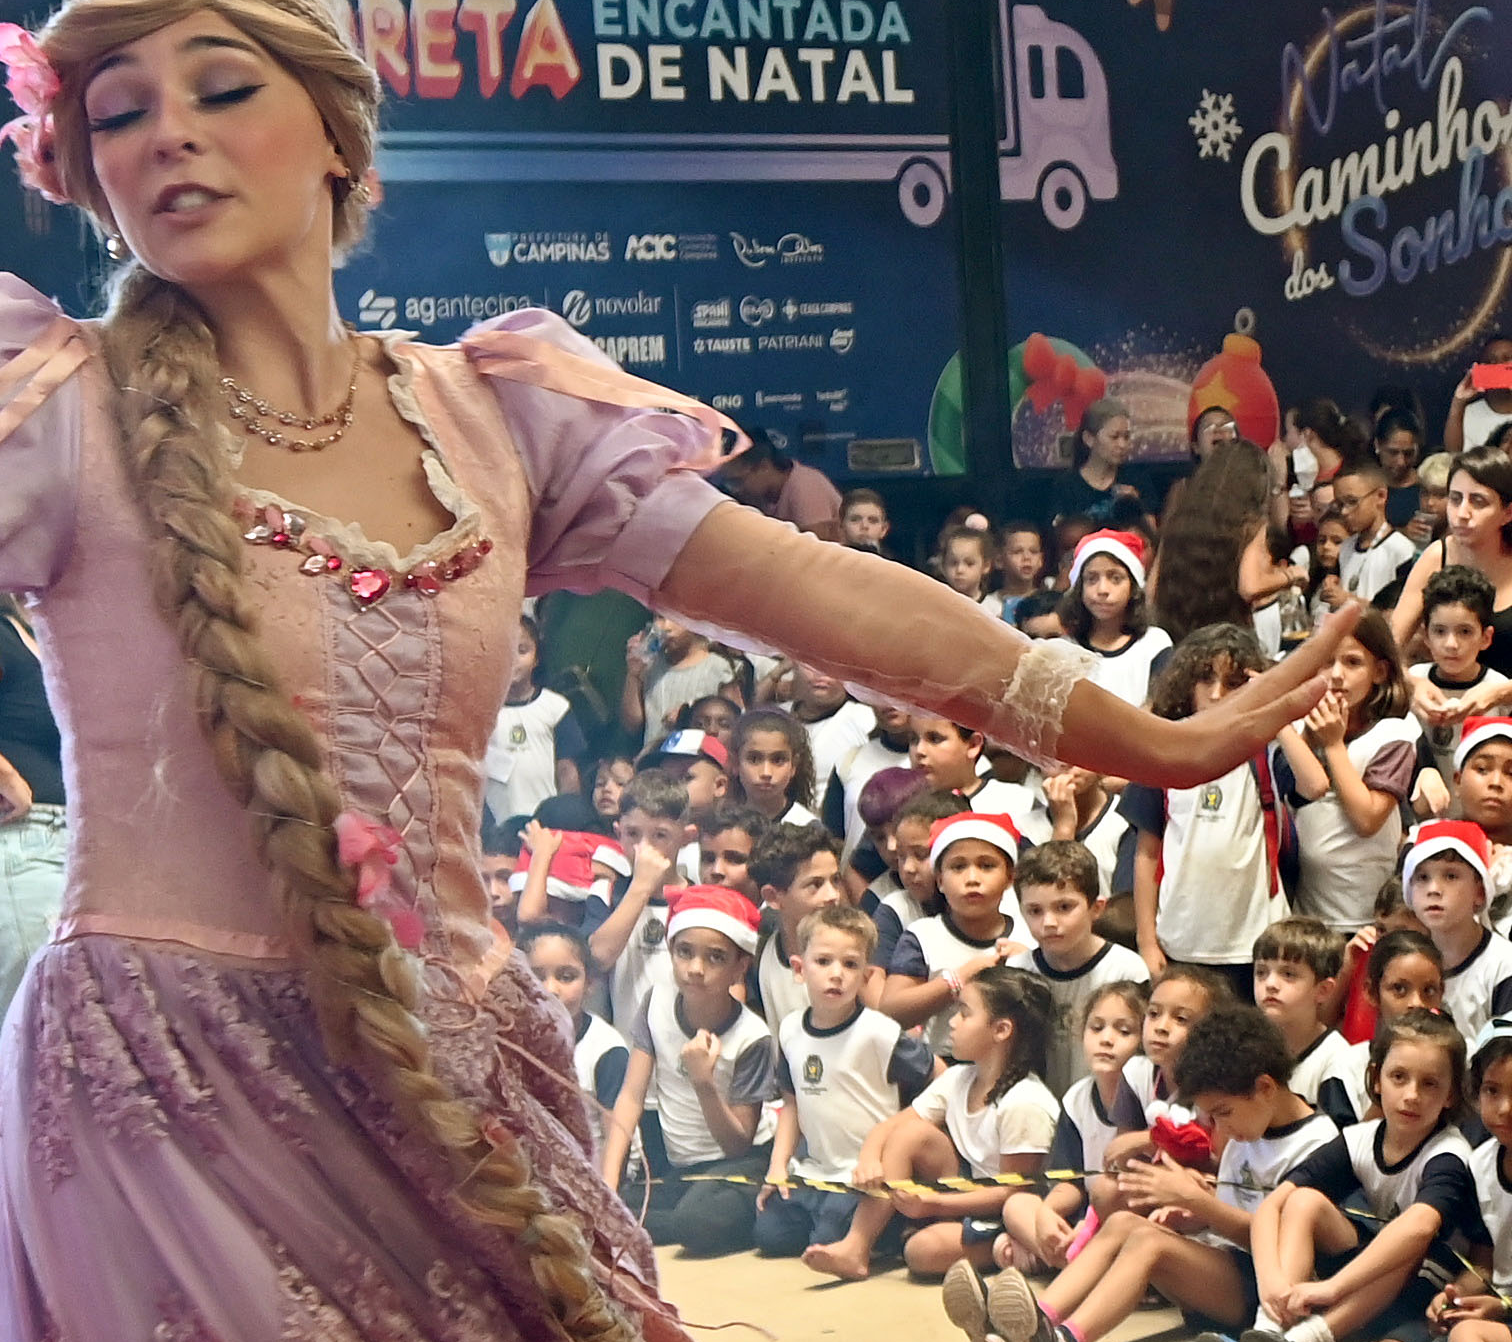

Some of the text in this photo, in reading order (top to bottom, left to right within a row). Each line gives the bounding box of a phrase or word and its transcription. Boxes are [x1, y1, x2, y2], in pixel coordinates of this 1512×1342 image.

[596, 43, 915, 104] DE NATAL
[513, 241, 611, 263] CAMPINAS
[624, 233, 677, 262] ACIC
[1284, 249, 1335, 302] dos
[595, 290, 663, 315] novolar
[707, 337, 751, 352] TAUSTE
[758, 335, 823, 350] PATRIANI
